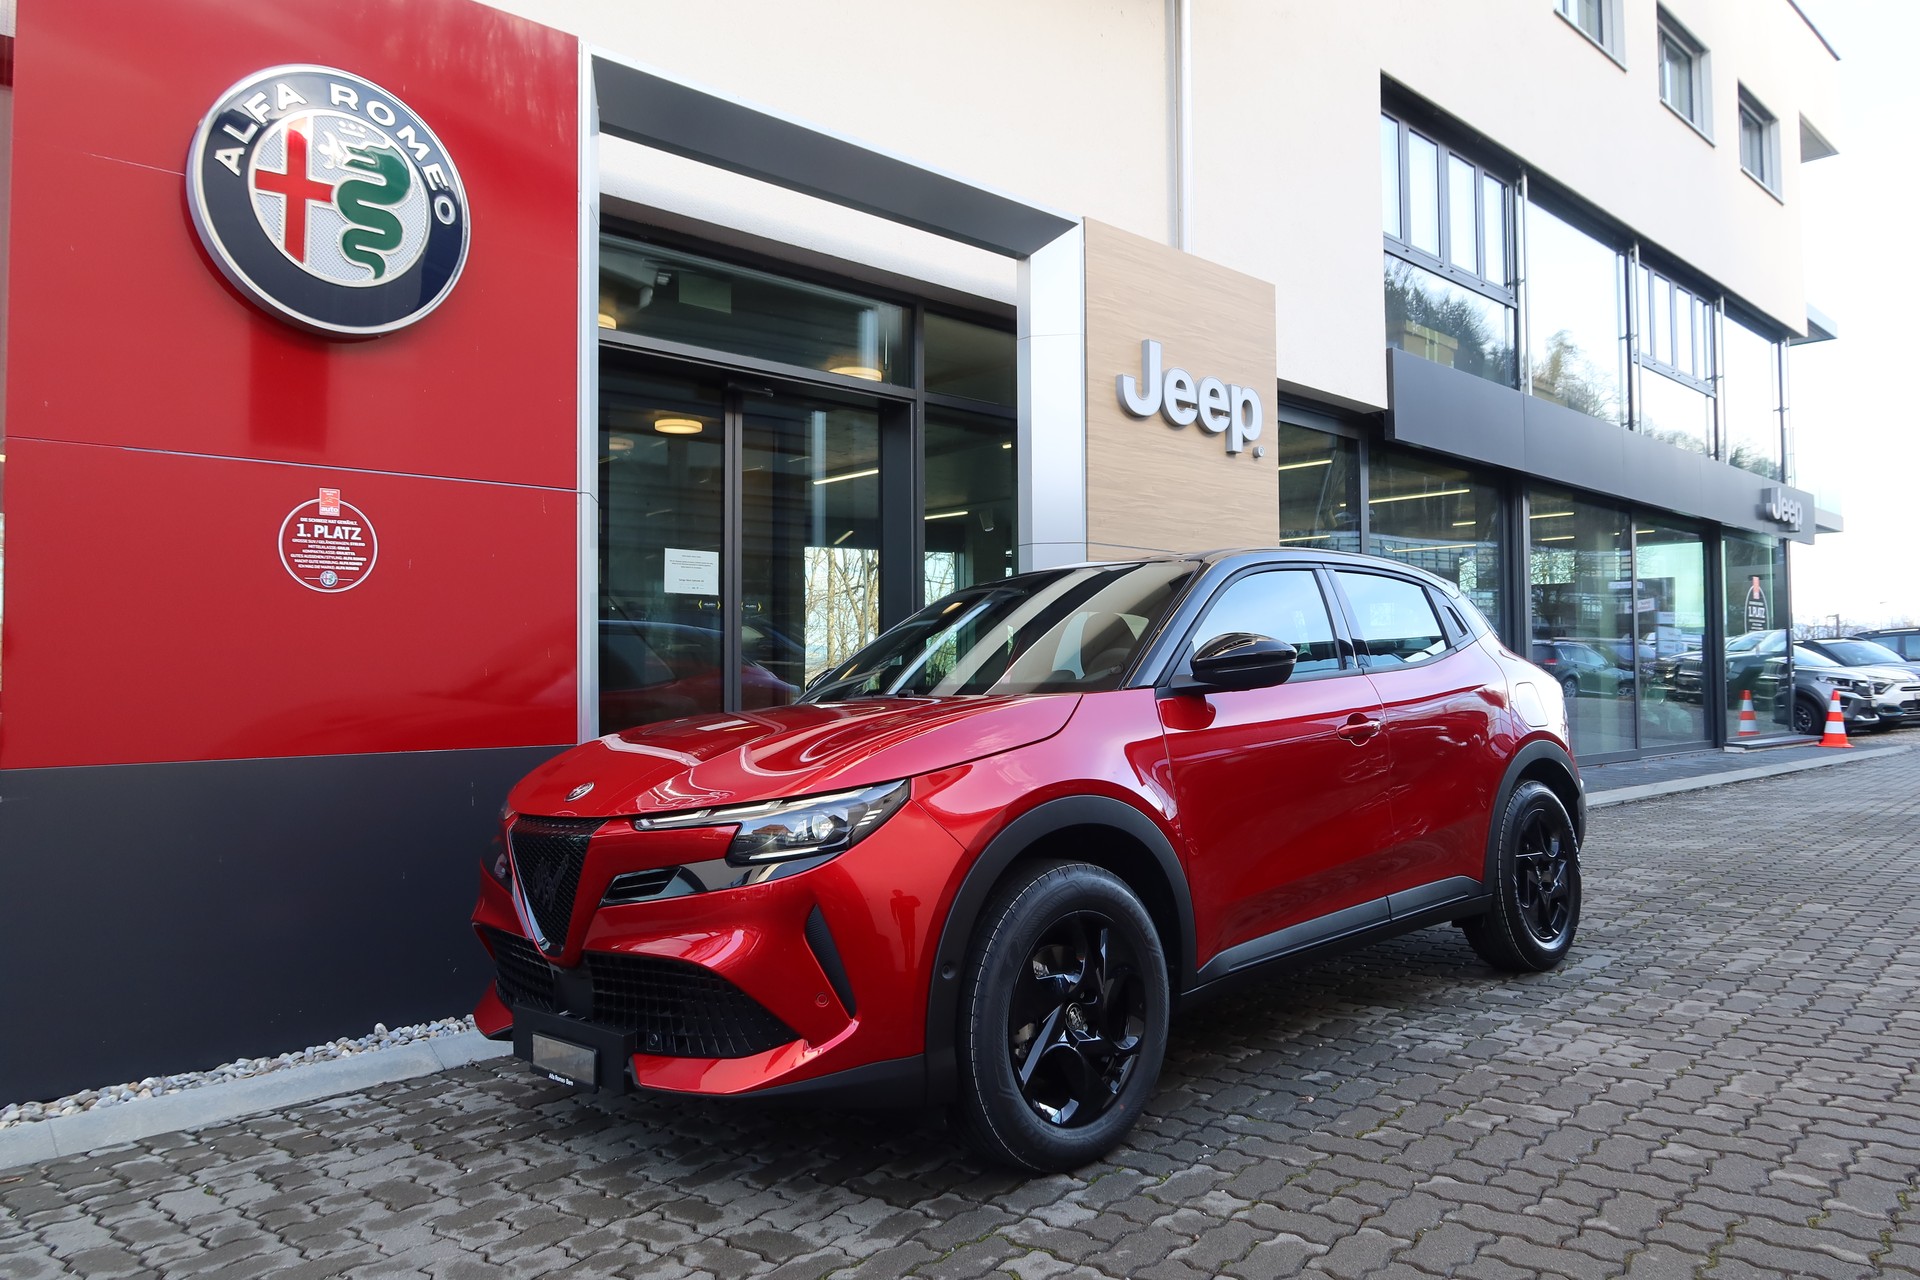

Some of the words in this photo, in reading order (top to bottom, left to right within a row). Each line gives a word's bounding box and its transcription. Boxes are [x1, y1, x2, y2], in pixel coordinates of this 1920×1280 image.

[214, 82, 309, 177] ALFA
[329, 82, 456, 225] ROMEO
[1116, 339, 1263, 454] Jeep
[296, 523, 311, 537] 1.
[314, 524, 362, 540] PLATZ
[1768, 488, 1803, 531] Jeep
